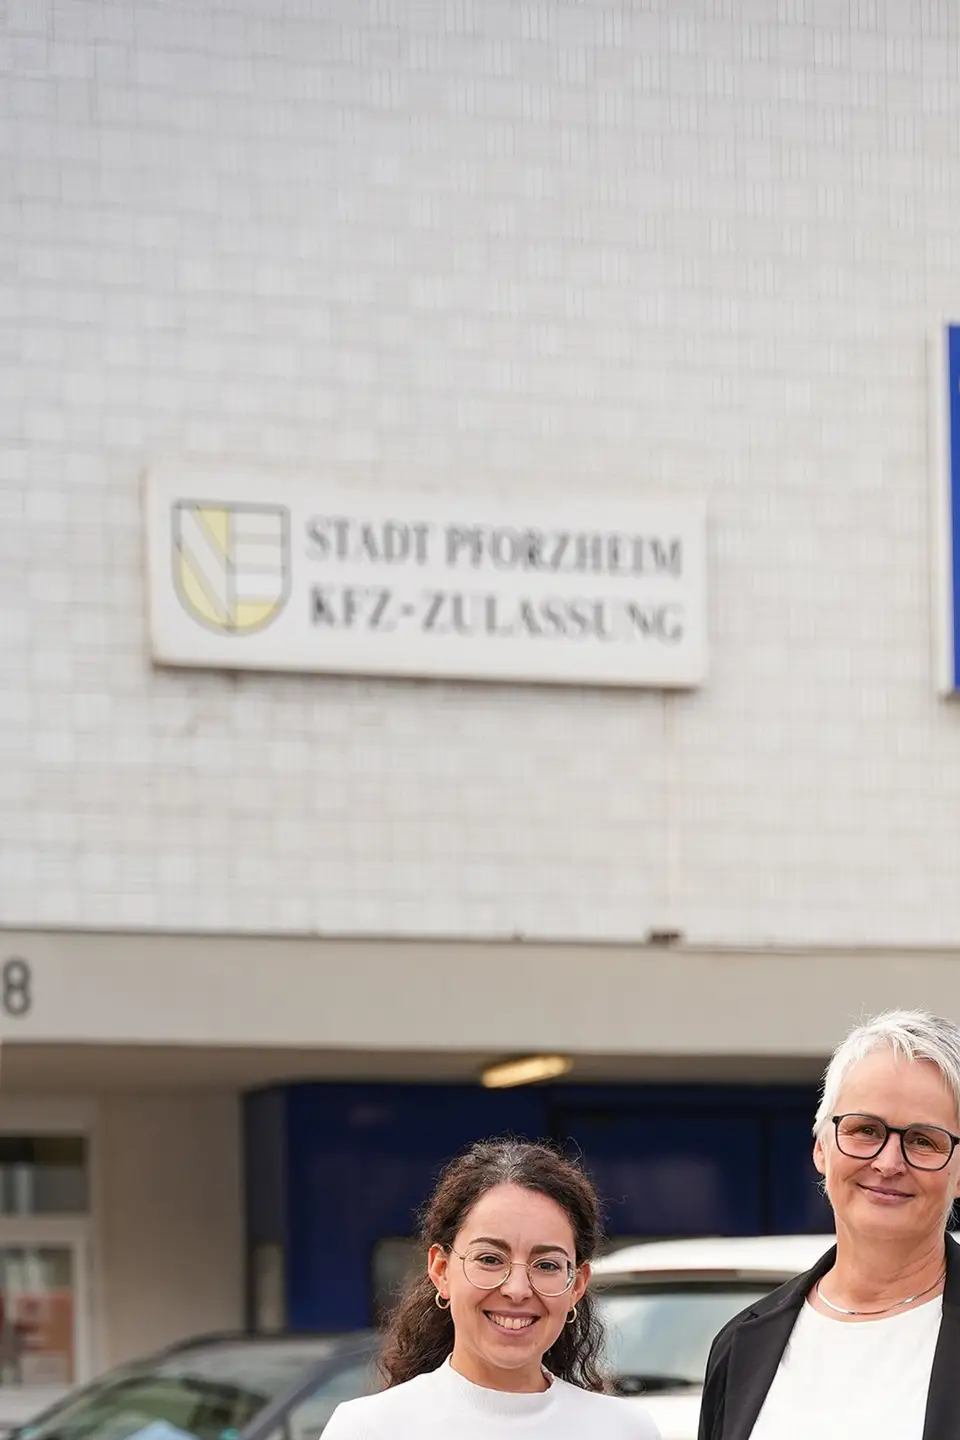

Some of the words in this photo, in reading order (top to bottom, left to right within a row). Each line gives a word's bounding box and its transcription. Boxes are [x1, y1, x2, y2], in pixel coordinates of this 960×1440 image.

[305, 516, 430, 564] STADT
[446, 524, 683, 576] PFORZHEIM
[309, 584, 684, 643] KFZ-ZULASSUNG
[2, 957, 32, 1017] 8
